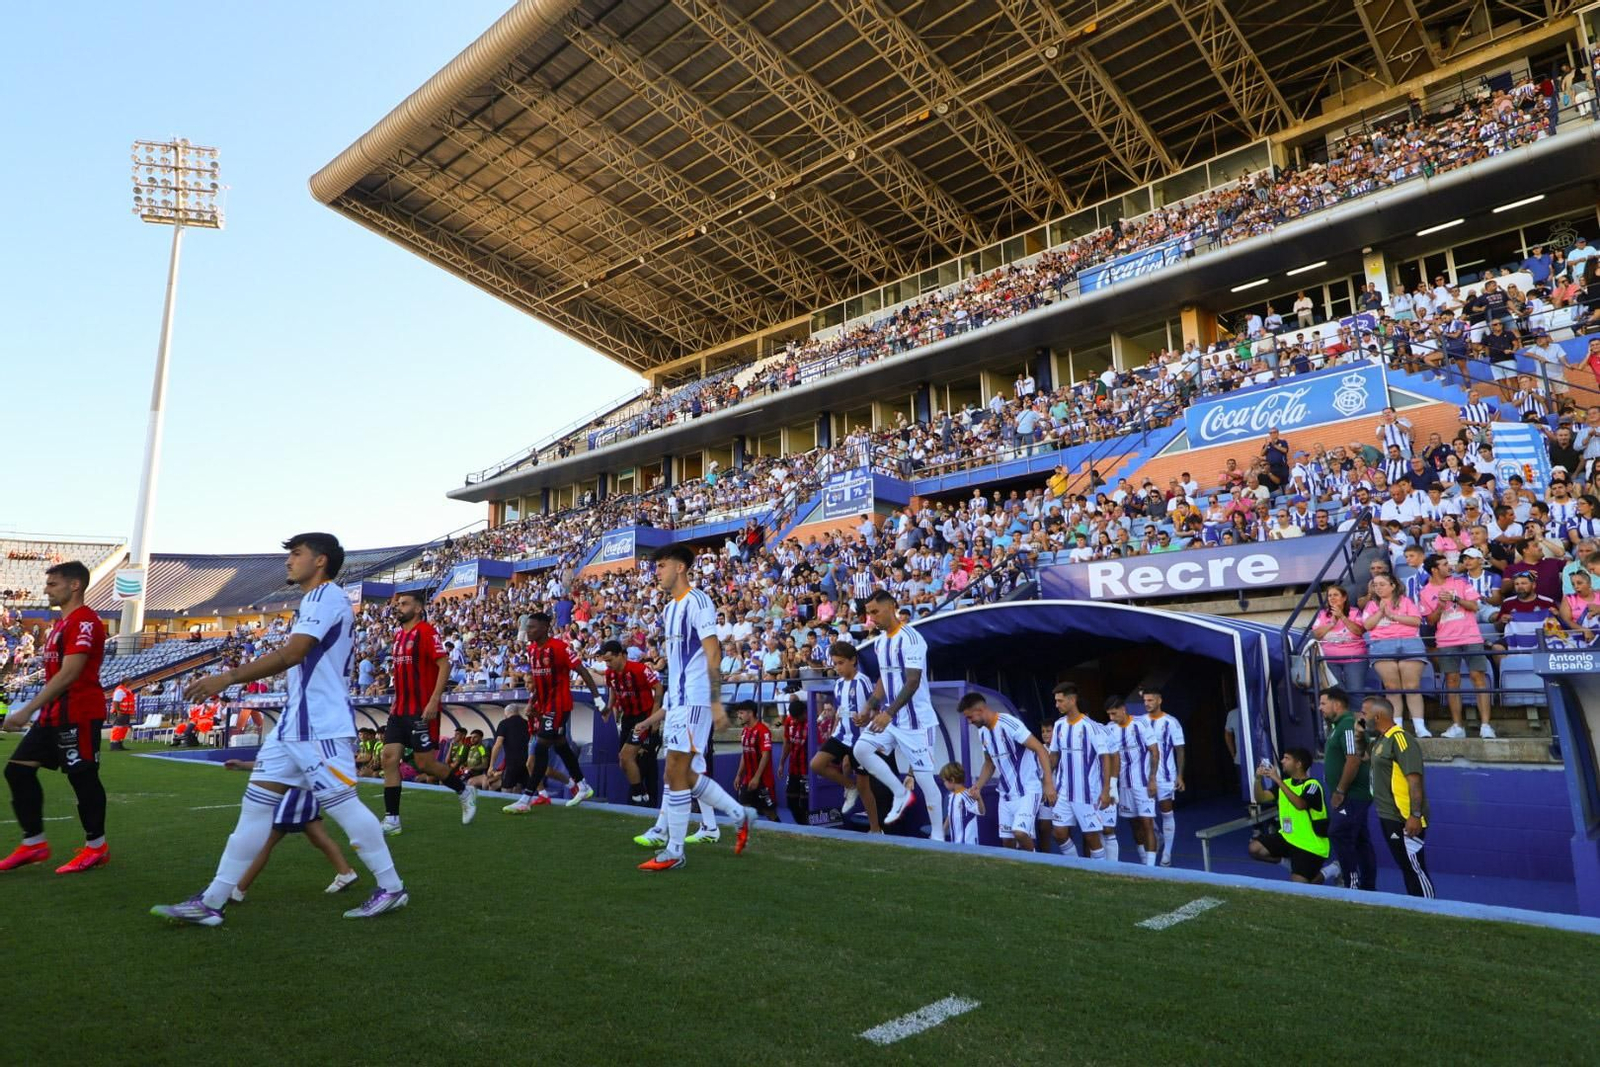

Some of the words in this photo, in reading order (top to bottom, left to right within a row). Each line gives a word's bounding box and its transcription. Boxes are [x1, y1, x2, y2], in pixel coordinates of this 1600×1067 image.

[1201, 386, 1312, 441] Coca-Cola
[1087, 553, 1280, 599] Recre
[1549, 652, 1593, 662] Antonio
